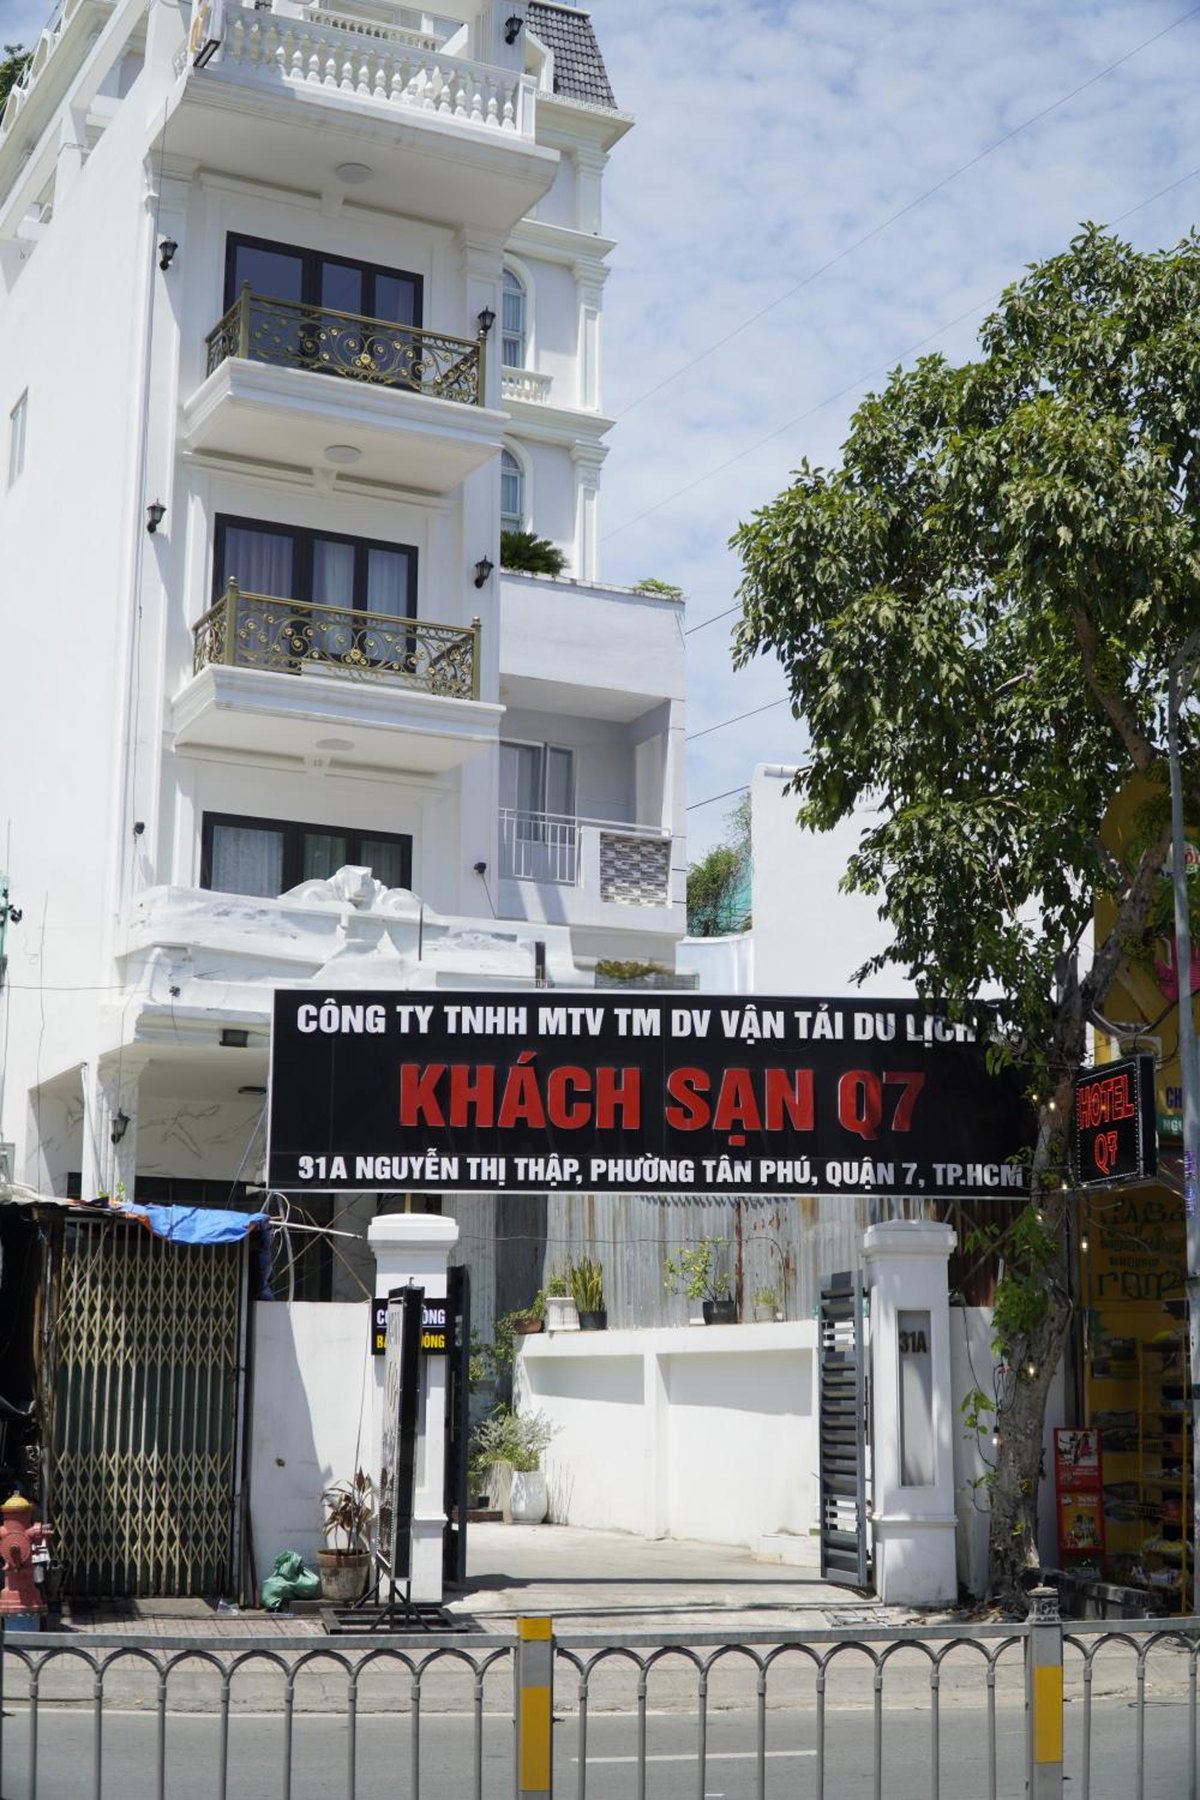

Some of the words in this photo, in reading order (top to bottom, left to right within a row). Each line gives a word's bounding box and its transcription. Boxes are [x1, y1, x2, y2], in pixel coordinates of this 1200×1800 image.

[297, 998, 386, 1033] CÔNG
[396, 1005, 434, 1033] TY
[444, 1006, 527, 1035] TNHH
[539, 1007, 605, 1035] MTV
[614, 1008, 660, 1036] TM
[672, 1009, 711, 1037] DV
[720, 1004, 784, 1044] VẬN
[794, 1003, 843, 1039] TẢI
[854, 1012, 895, 1041] DU
[400, 1051, 640, 1129] KHÁCH
[666, 1067, 815, 1145] SẠN
[839, 1069, 926, 1140] Q7
[1079, 1075, 1134, 1129] HOTEL
[299, 1156, 348, 1179] 31A
[356, 1148, 459, 1180] NGUYỄN
[466, 1157, 506, 1186] THỊ
[514, 1153, 582, 1186] THẬP,
[591, 1153, 694, 1182] PHƯỜNG
[702, 1154, 751, 1182] TÂN
[760, 1155, 818, 1186] PHÚ,
[826, 1157, 894, 1189] QUẬN
[902, 1163, 924, 1187] 7,
[933, 1164, 1022, 1186] TP.HCM
[1095, 1131, 1118, 1174] Q7
[899, 1330, 928, 1353] 31A
